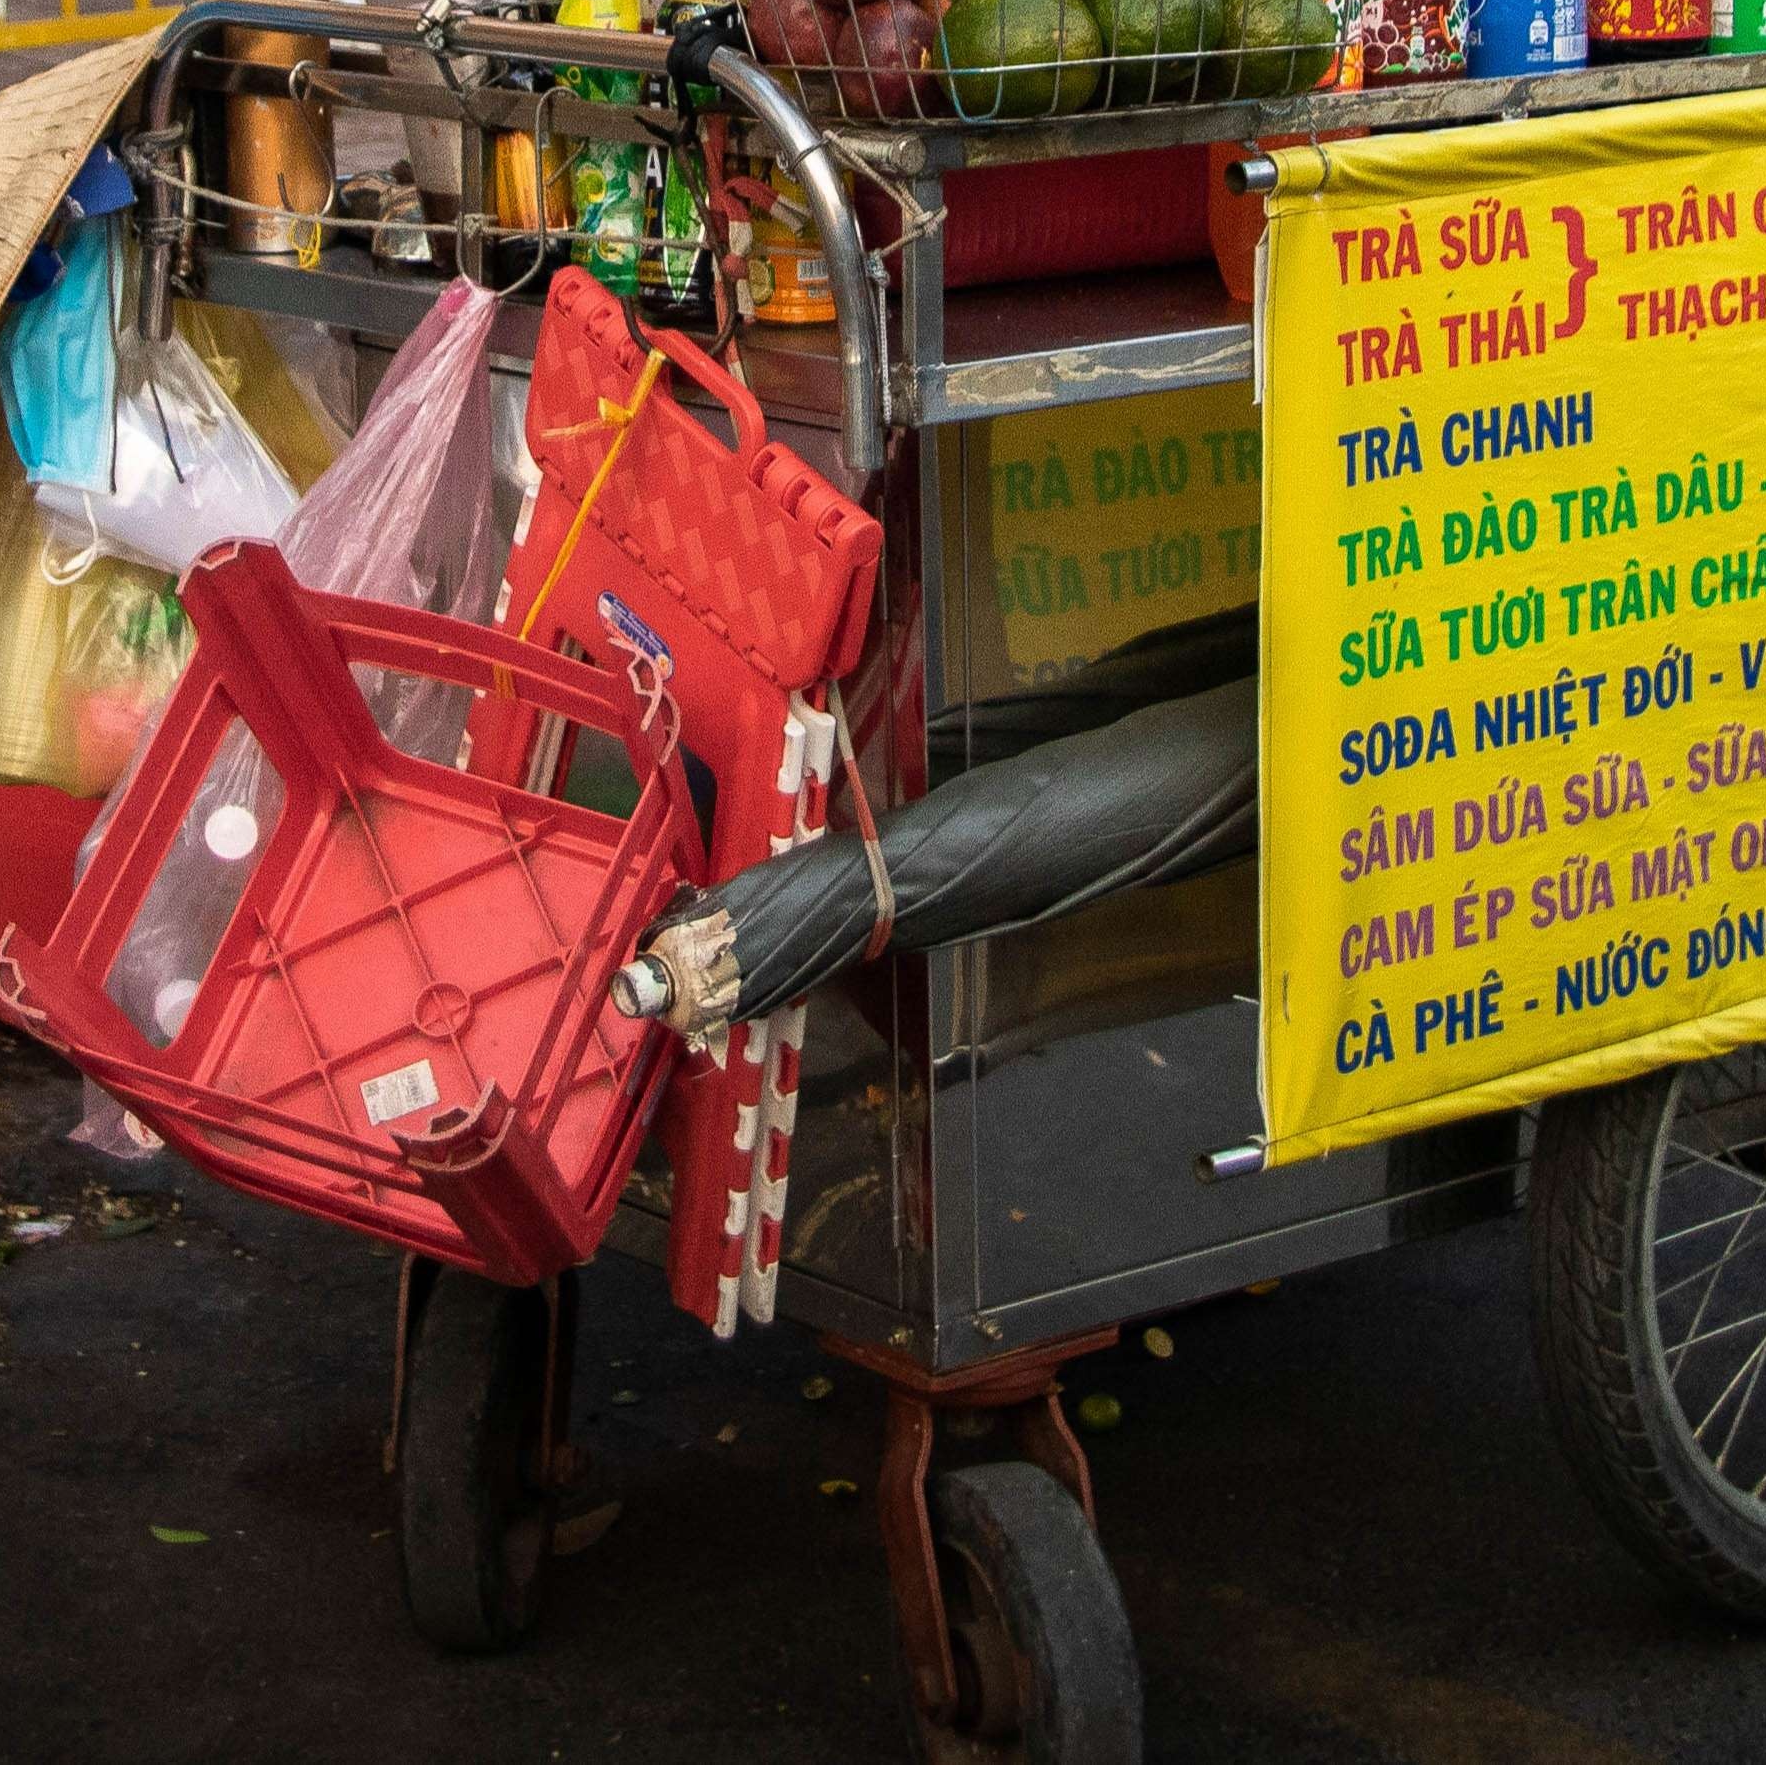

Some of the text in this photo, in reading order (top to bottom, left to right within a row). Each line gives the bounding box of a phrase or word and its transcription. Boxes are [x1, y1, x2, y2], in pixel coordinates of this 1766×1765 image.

[1332, 198, 1529, 285] TRÀ SỮA
[1617, 185, 1737, 254] TRÂN
[1337, 290, 1546, 387] TRÀ THÁI
[1338, 391, 1593, 488] TRÀ CHANH
[1338, 506, 1423, 587] TRÀ
[1442, 492, 1538, 565] ĐÀO
[1551, 467, 1638, 543] TRÀ
[1656, 452, 1744, 524] DÂU
[1339, 610, 1424, 687] SỮA
[1440, 586, 1545, 661] TƯƠI
[1560, 559, 1676, 636] TRÂN
[1339, 708, 1457, 786] SOĐA
[1474, 667, 1607, 752] NHIỆT
[1622, 643, 1693, 718] ĐỚI
[1340, 806, 1434, 883] SÂM
[1454, 777, 1547, 853] DỨA
[1563, 755, 1649, 826] SỮA
[1340, 904, 1434, 980] CAM
[1454, 880, 1515, 948] ÉP
[1531, 855, 1615, 929] SỮA
[1631, 828, 1716, 902] MẬT
[1335, 999, 1395, 1075] CÀ
[1415, 969, 1504, 1054] PHÊ
[1556, 931, 1670, 1016] NƯỚC
